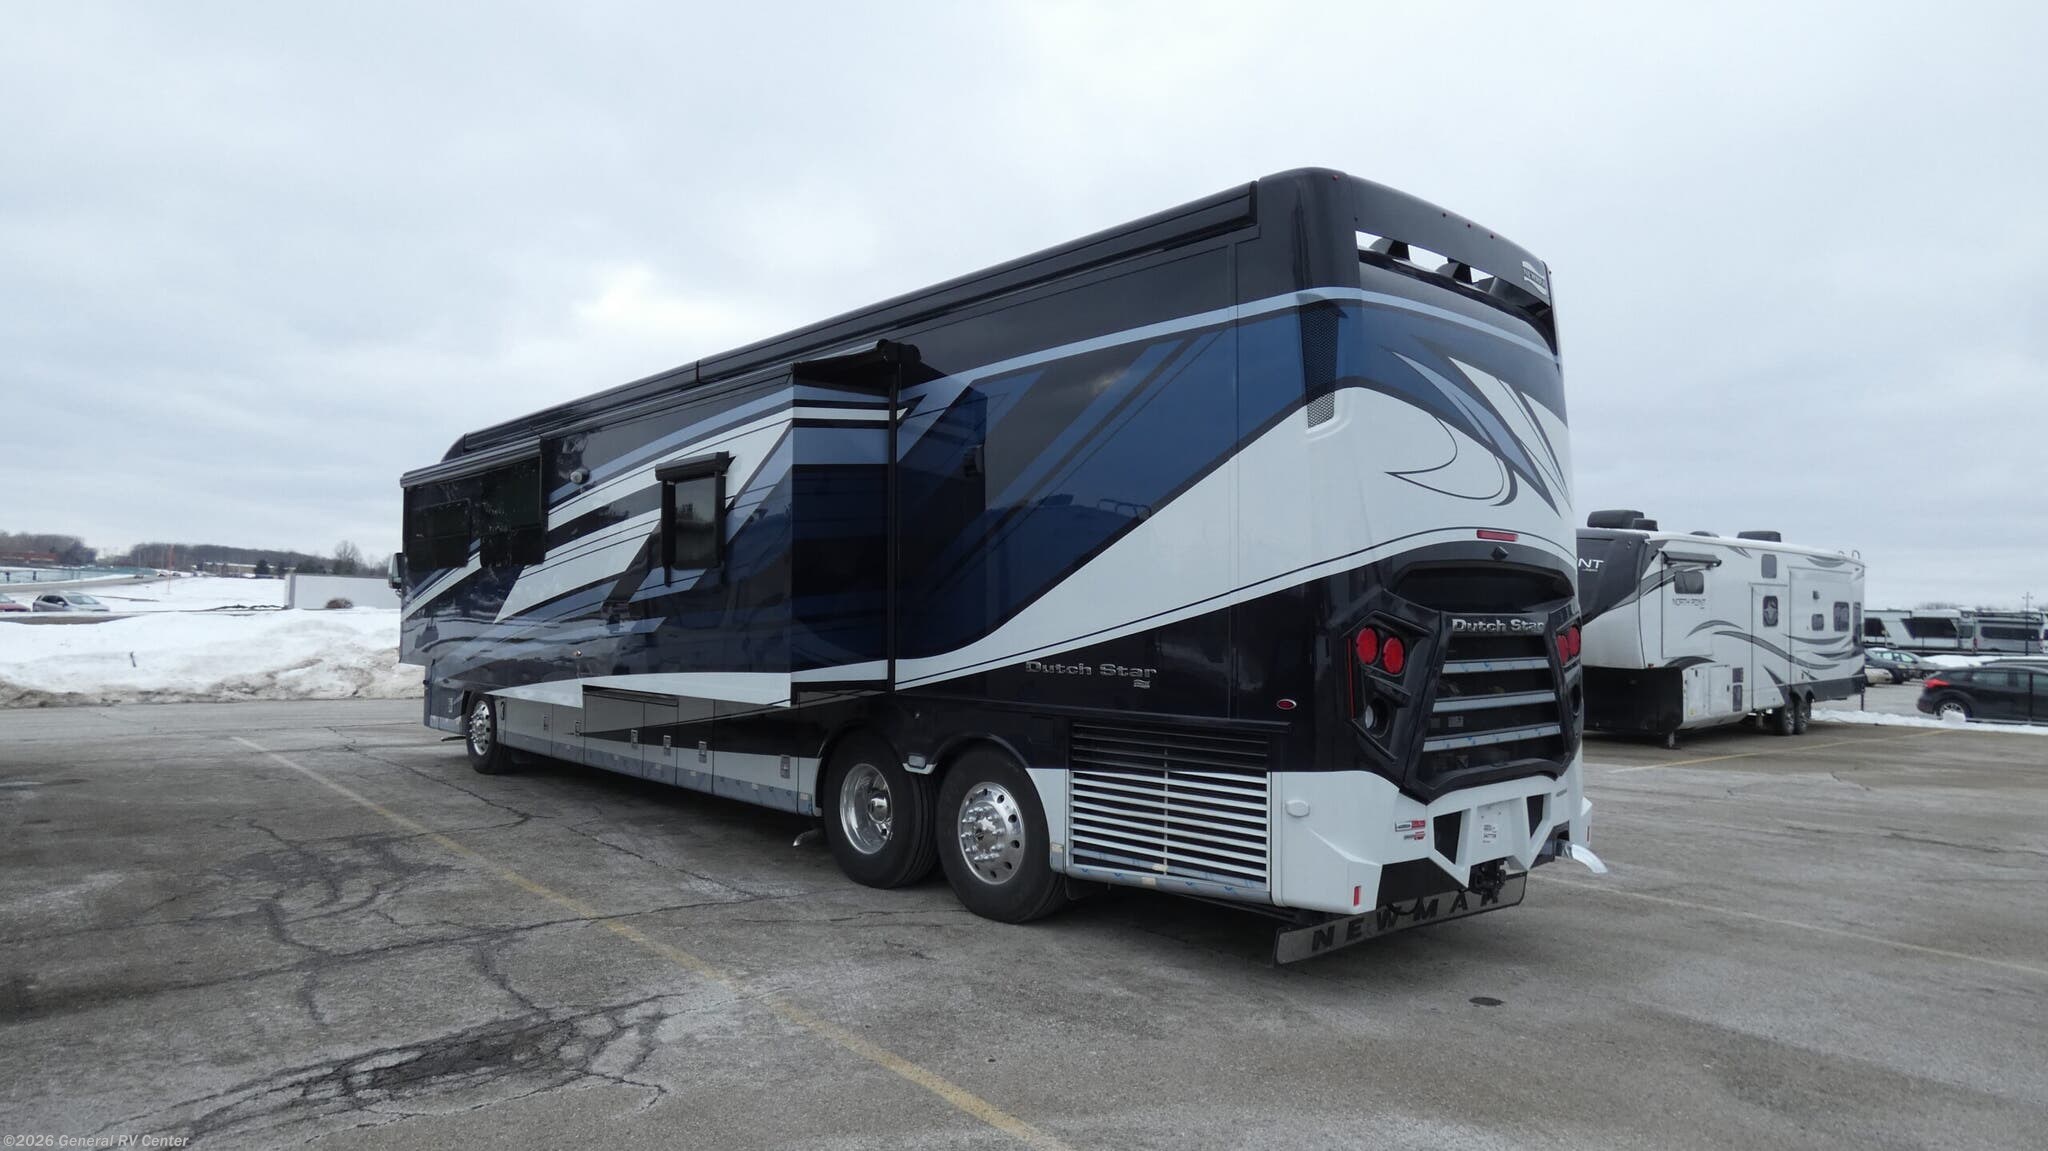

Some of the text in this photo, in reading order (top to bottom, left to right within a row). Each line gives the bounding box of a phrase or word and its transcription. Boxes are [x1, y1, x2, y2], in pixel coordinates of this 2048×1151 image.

[1452, 619, 1545, 632] Dutch Star
[1025, 661, 1158, 678] Dutch Star
